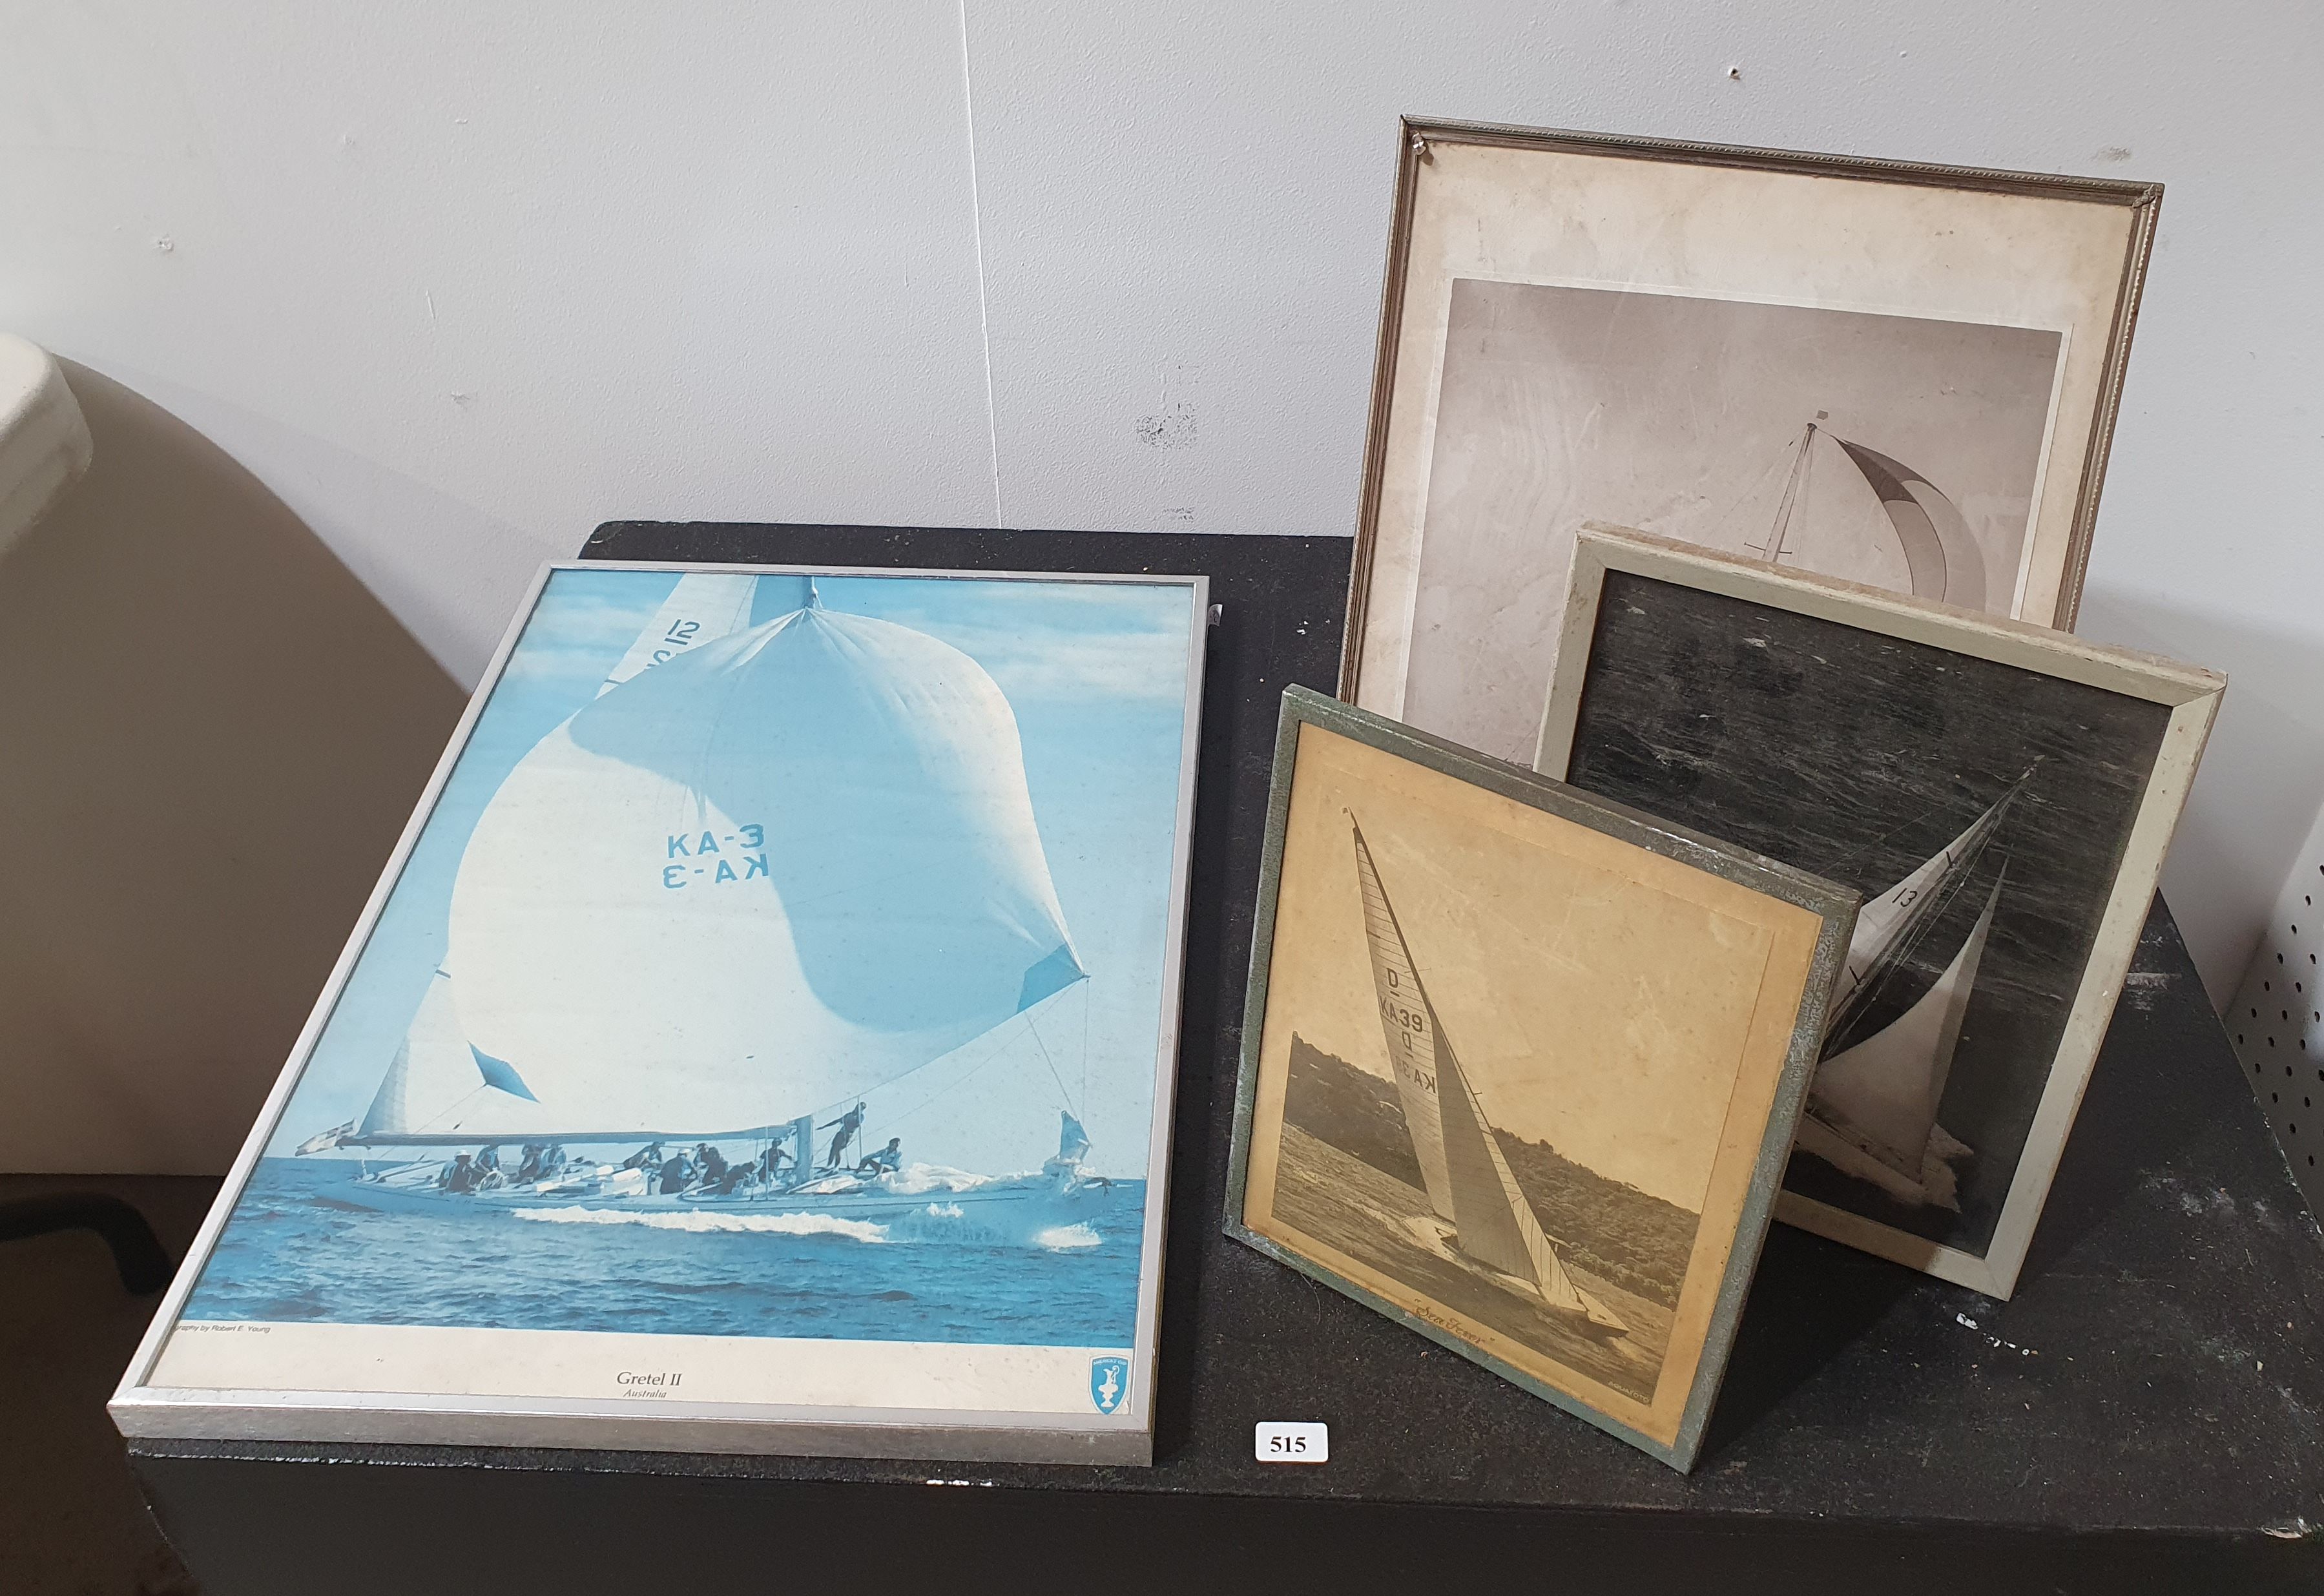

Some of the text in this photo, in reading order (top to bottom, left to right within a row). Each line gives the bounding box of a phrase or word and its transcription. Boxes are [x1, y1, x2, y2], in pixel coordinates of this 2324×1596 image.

[667, 619, 701, 639] 12
[668, 824, 765, 858] KA-3
[1892, 887, 1918, 907] 13
[248, 1325, 271, 1334] Young
[617, 1371, 683, 1386] Gretel II
[623, 1389, 667, 1398] Australia
[1270, 1436, 1306, 1453] 515
